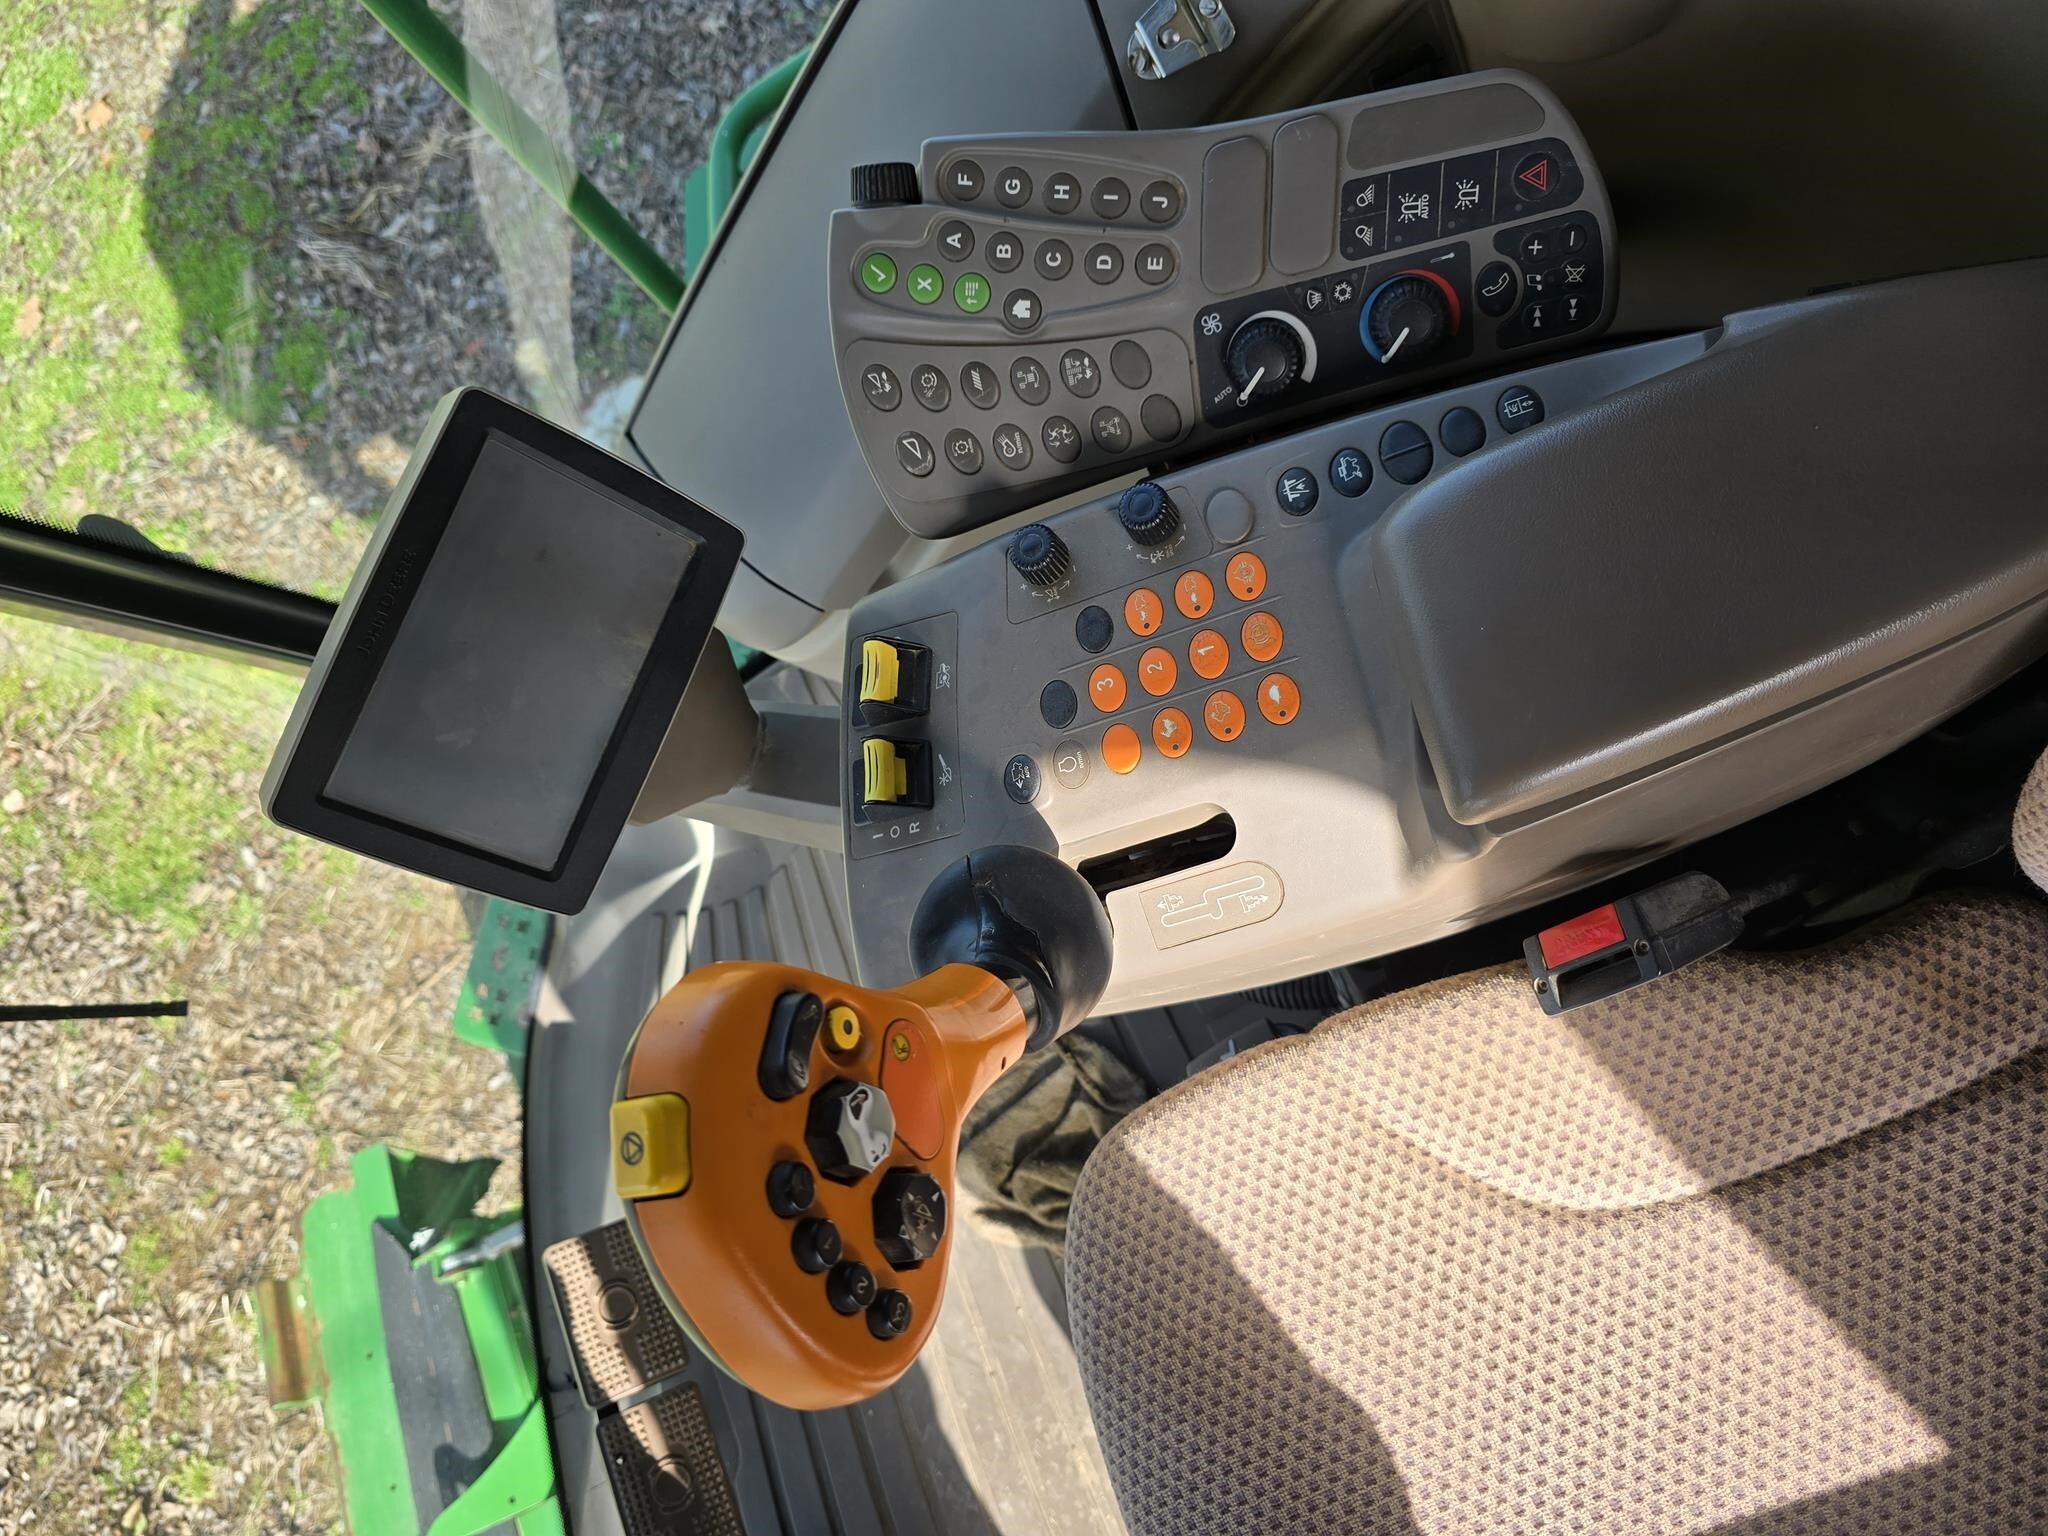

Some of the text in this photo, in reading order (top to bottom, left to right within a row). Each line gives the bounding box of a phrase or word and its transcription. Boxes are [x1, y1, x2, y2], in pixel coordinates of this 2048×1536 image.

[957, 173, 973, 186] F
[1005, 179, 1021, 195] G
[1053, 185, 1070, 200] H
[1152, 196, 1168, 209] J
[1421, 194, 1429, 219] AUTO
[946, 232, 962, 249] A
[996, 244, 1012, 259] B
[1045, 252, 1062, 267] C
[1096, 255, 1112, 270] D
[1147, 257, 1163, 270] E
[1214, 386, 1232, 404] AUTO
[1197, 645, 1215, 656] 1
[1146, 661, 1163, 674] 2
[1096, 677, 1114, 692] 3
[909, 821, 920, 834] R
[856, 1276, 869, 1294] 2
